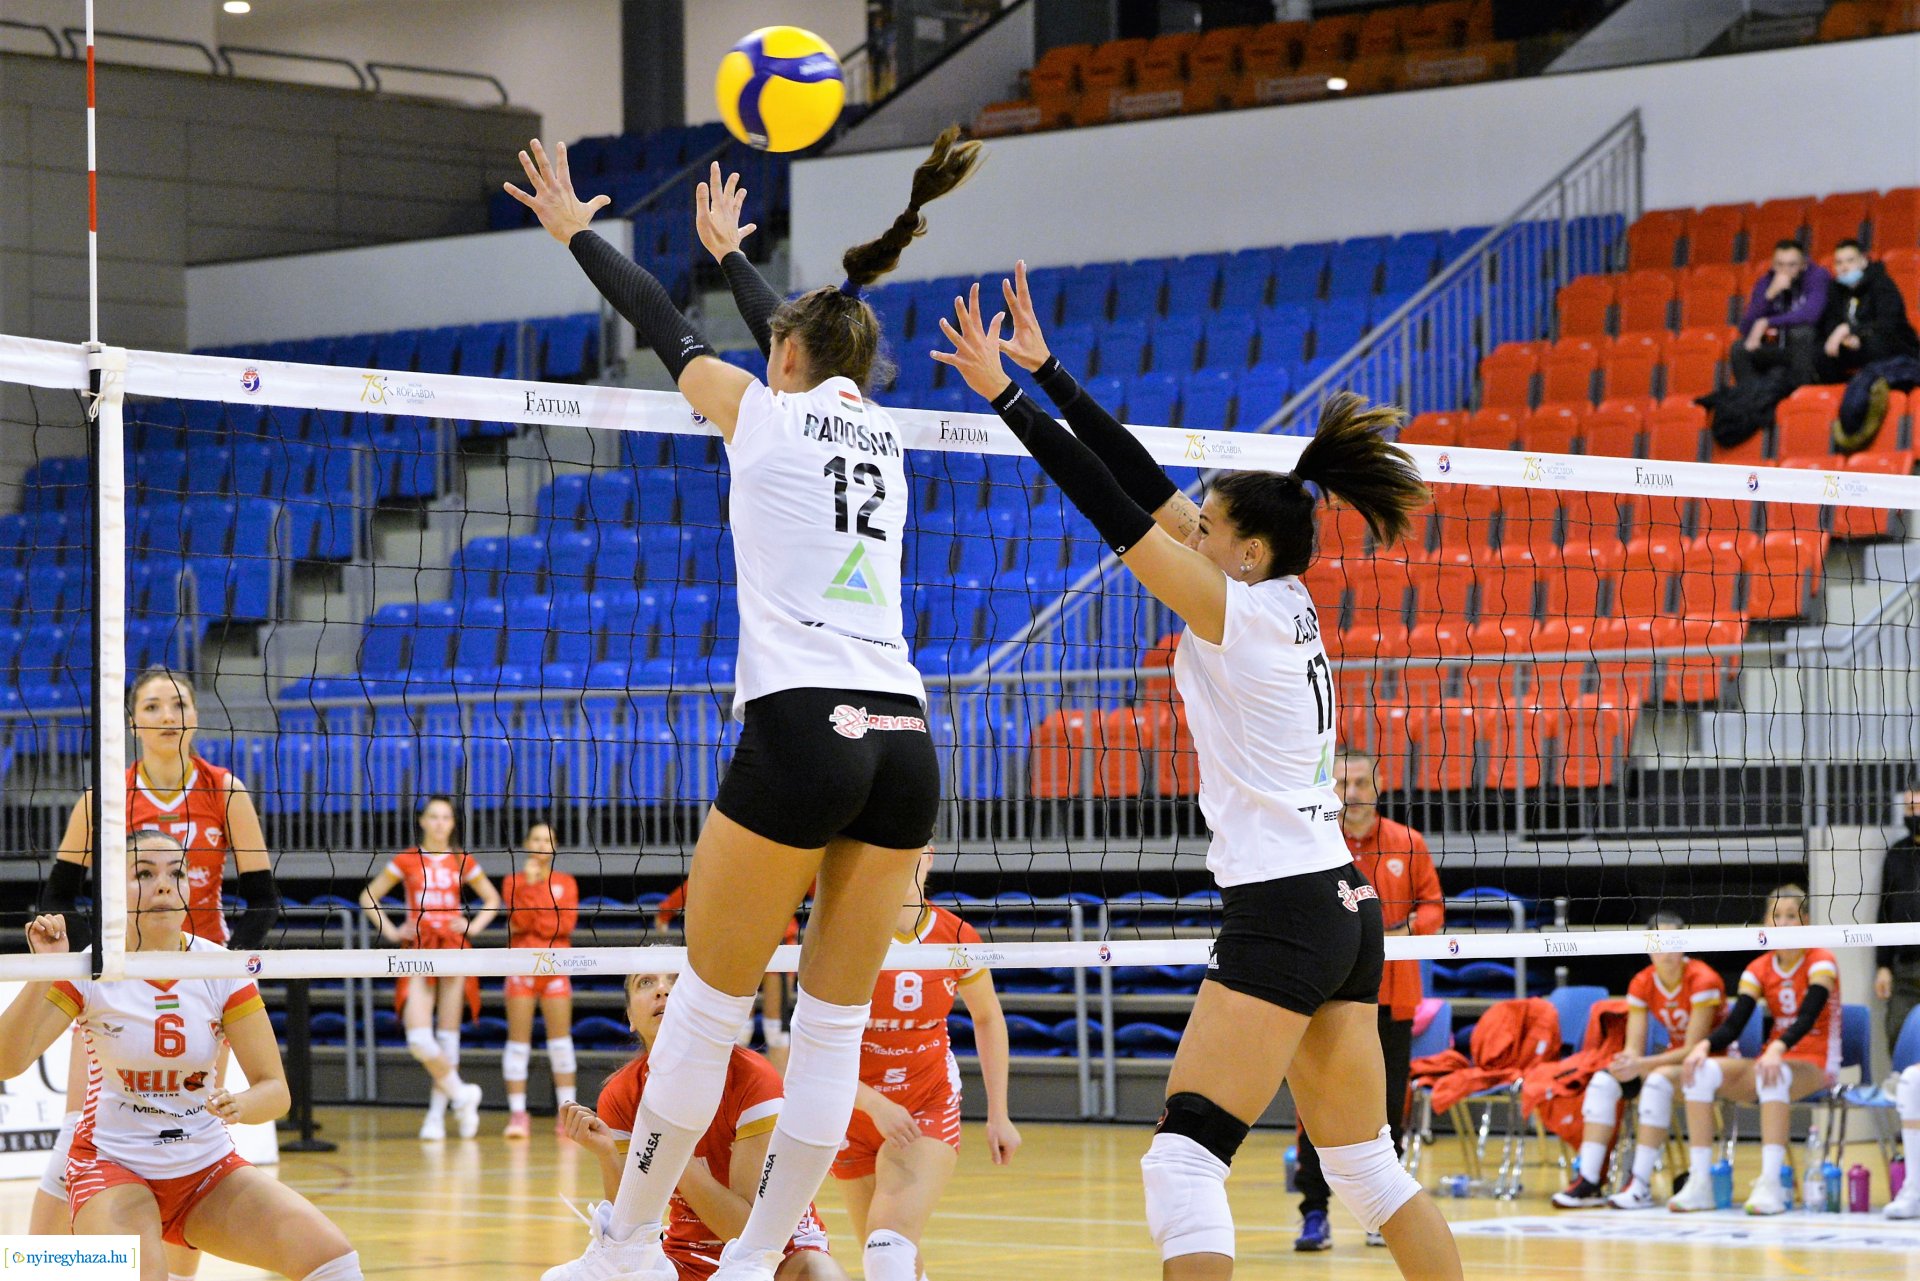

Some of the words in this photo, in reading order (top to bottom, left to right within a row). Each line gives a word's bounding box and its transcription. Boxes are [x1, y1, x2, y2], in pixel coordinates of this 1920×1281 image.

[523, 390, 581, 415] FATUM
[940, 420, 989, 442] FATUM
[1635, 466, 1674, 487] FATUM
[824, 455, 887, 542] 12
[1307, 652, 1332, 735] 17
[1544, 938, 1578, 953] FATUM
[387, 955, 435, 973] FATUM
[893, 971, 923, 1012] 8
[1778, 988, 1796, 1015] 9
[154, 1013, 186, 1058] 6
[116, 1068, 181, 1093] HELL
[637, 1131, 662, 1175] MIKASA
[759, 1153, 777, 1199] MIKASA
